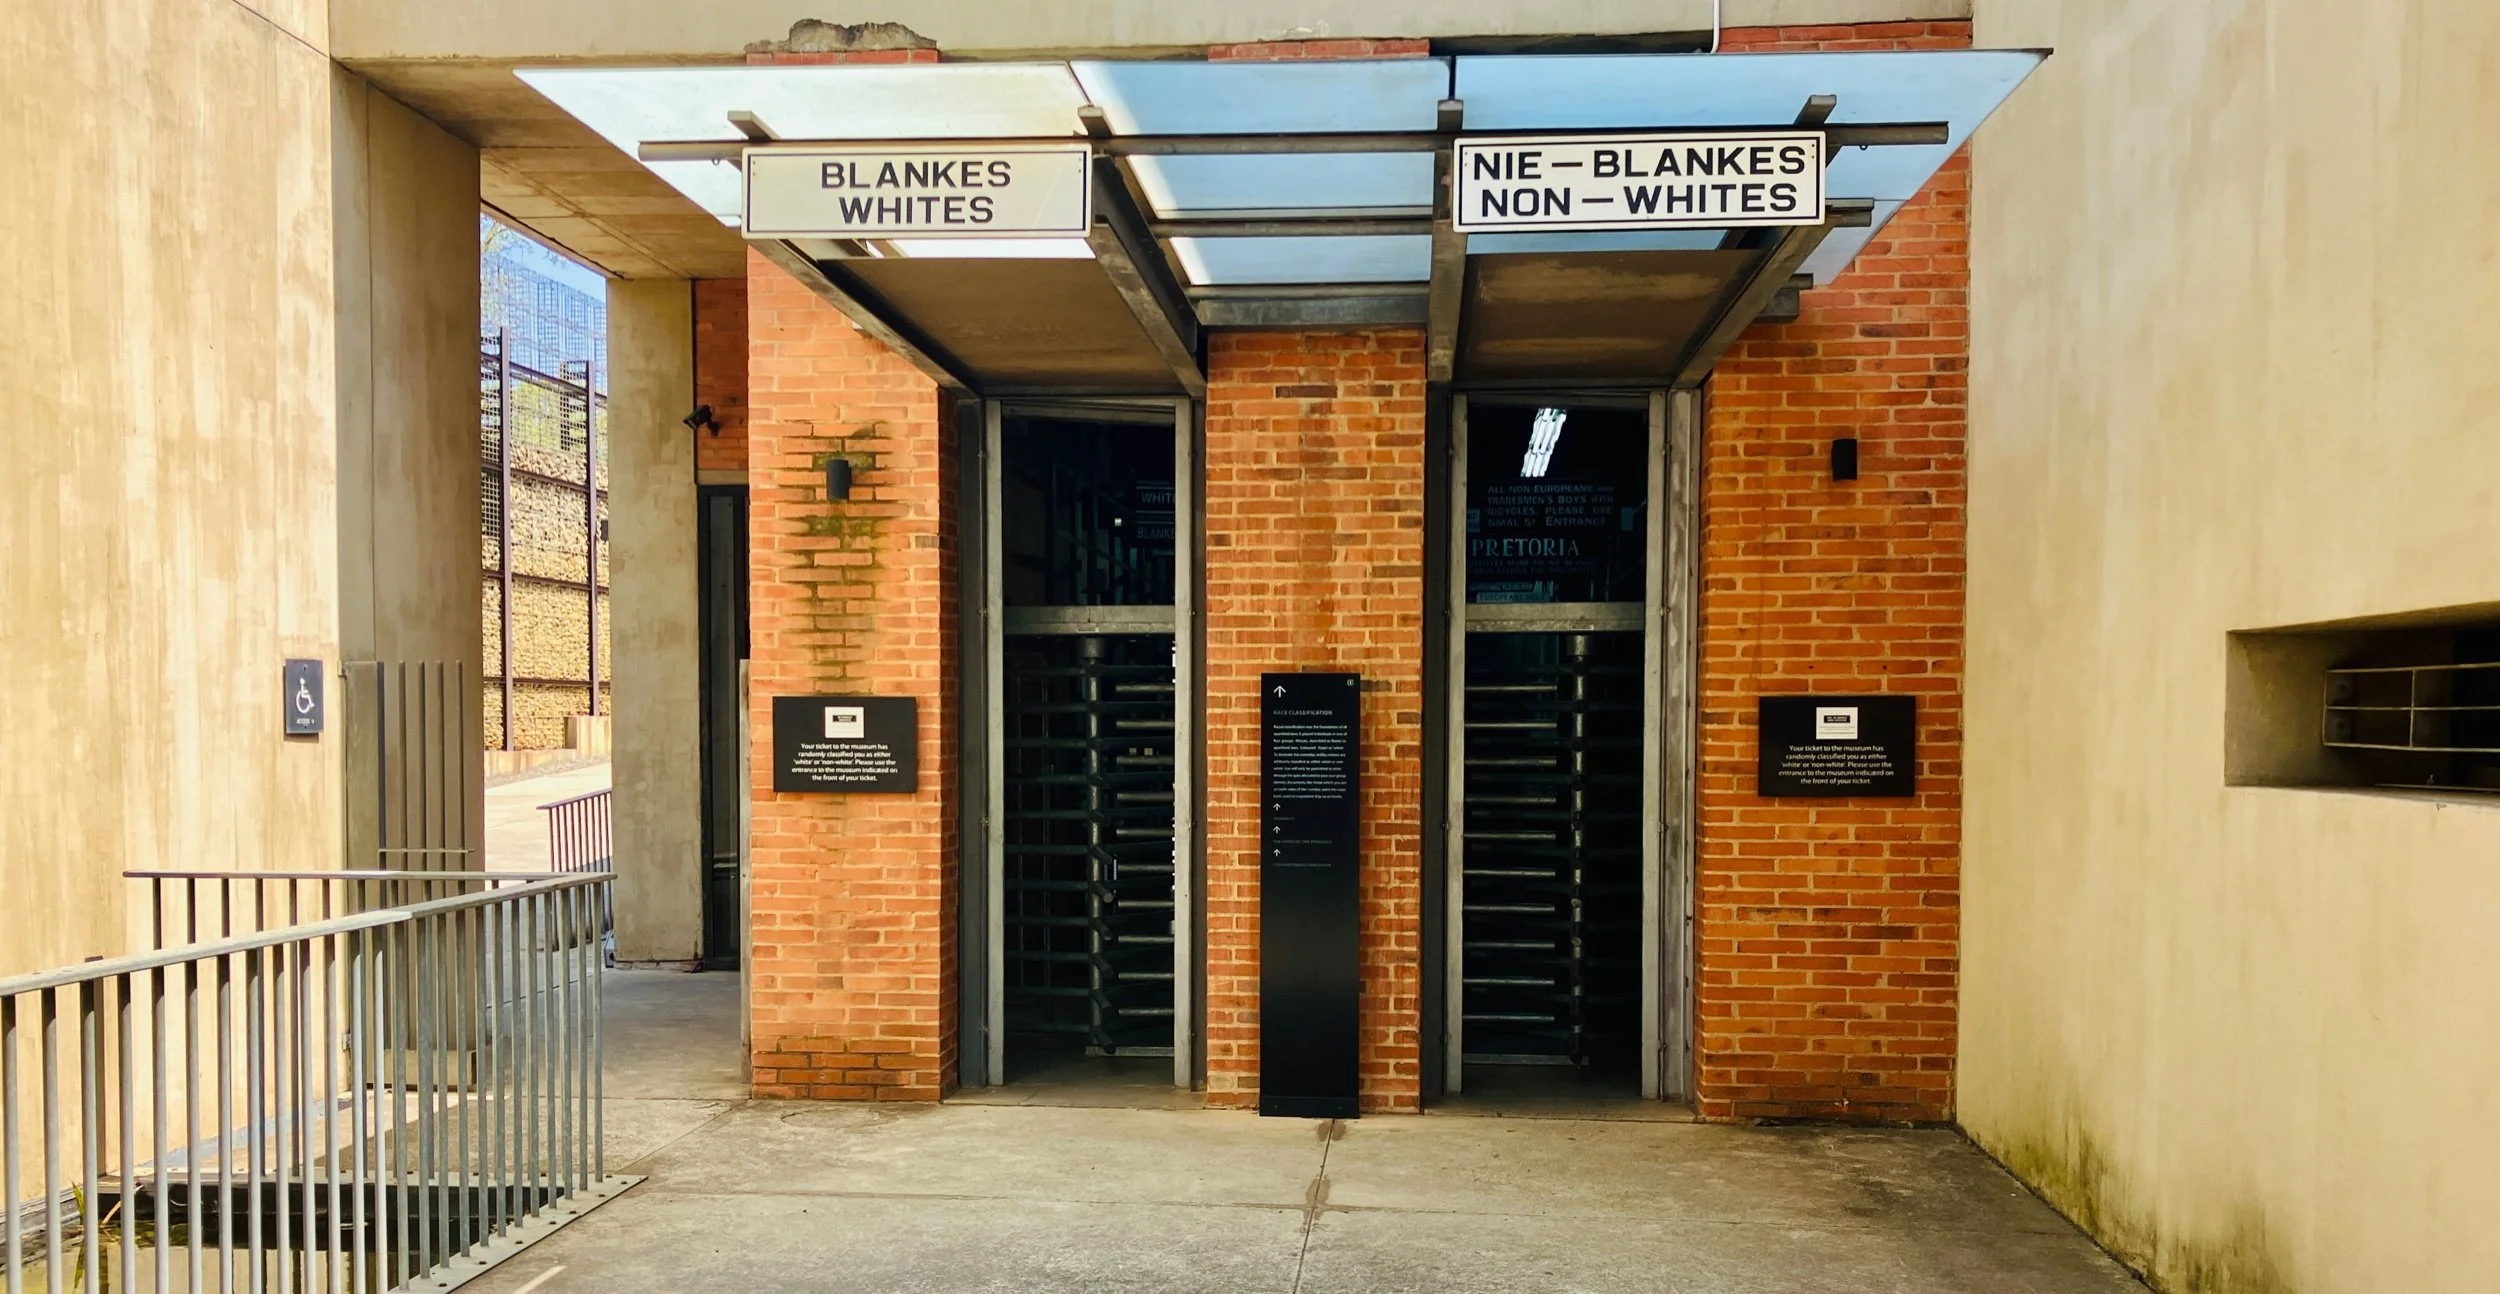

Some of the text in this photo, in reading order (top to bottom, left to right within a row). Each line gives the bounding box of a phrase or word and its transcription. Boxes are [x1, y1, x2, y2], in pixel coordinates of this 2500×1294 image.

[821, 161, 1012, 189] BLANKES
[838, 195, 994, 225] WHITES
[1487, 485, 1507, 494] ALL
[1557, 494, 1586, 505] BOYS
[1591, 494, 1614, 504] WITH
[1545, 504, 1584, 515] PLEASE
[1592, 504, 1612, 514] USE
[1471, 538, 1580, 557] PRETORIA
